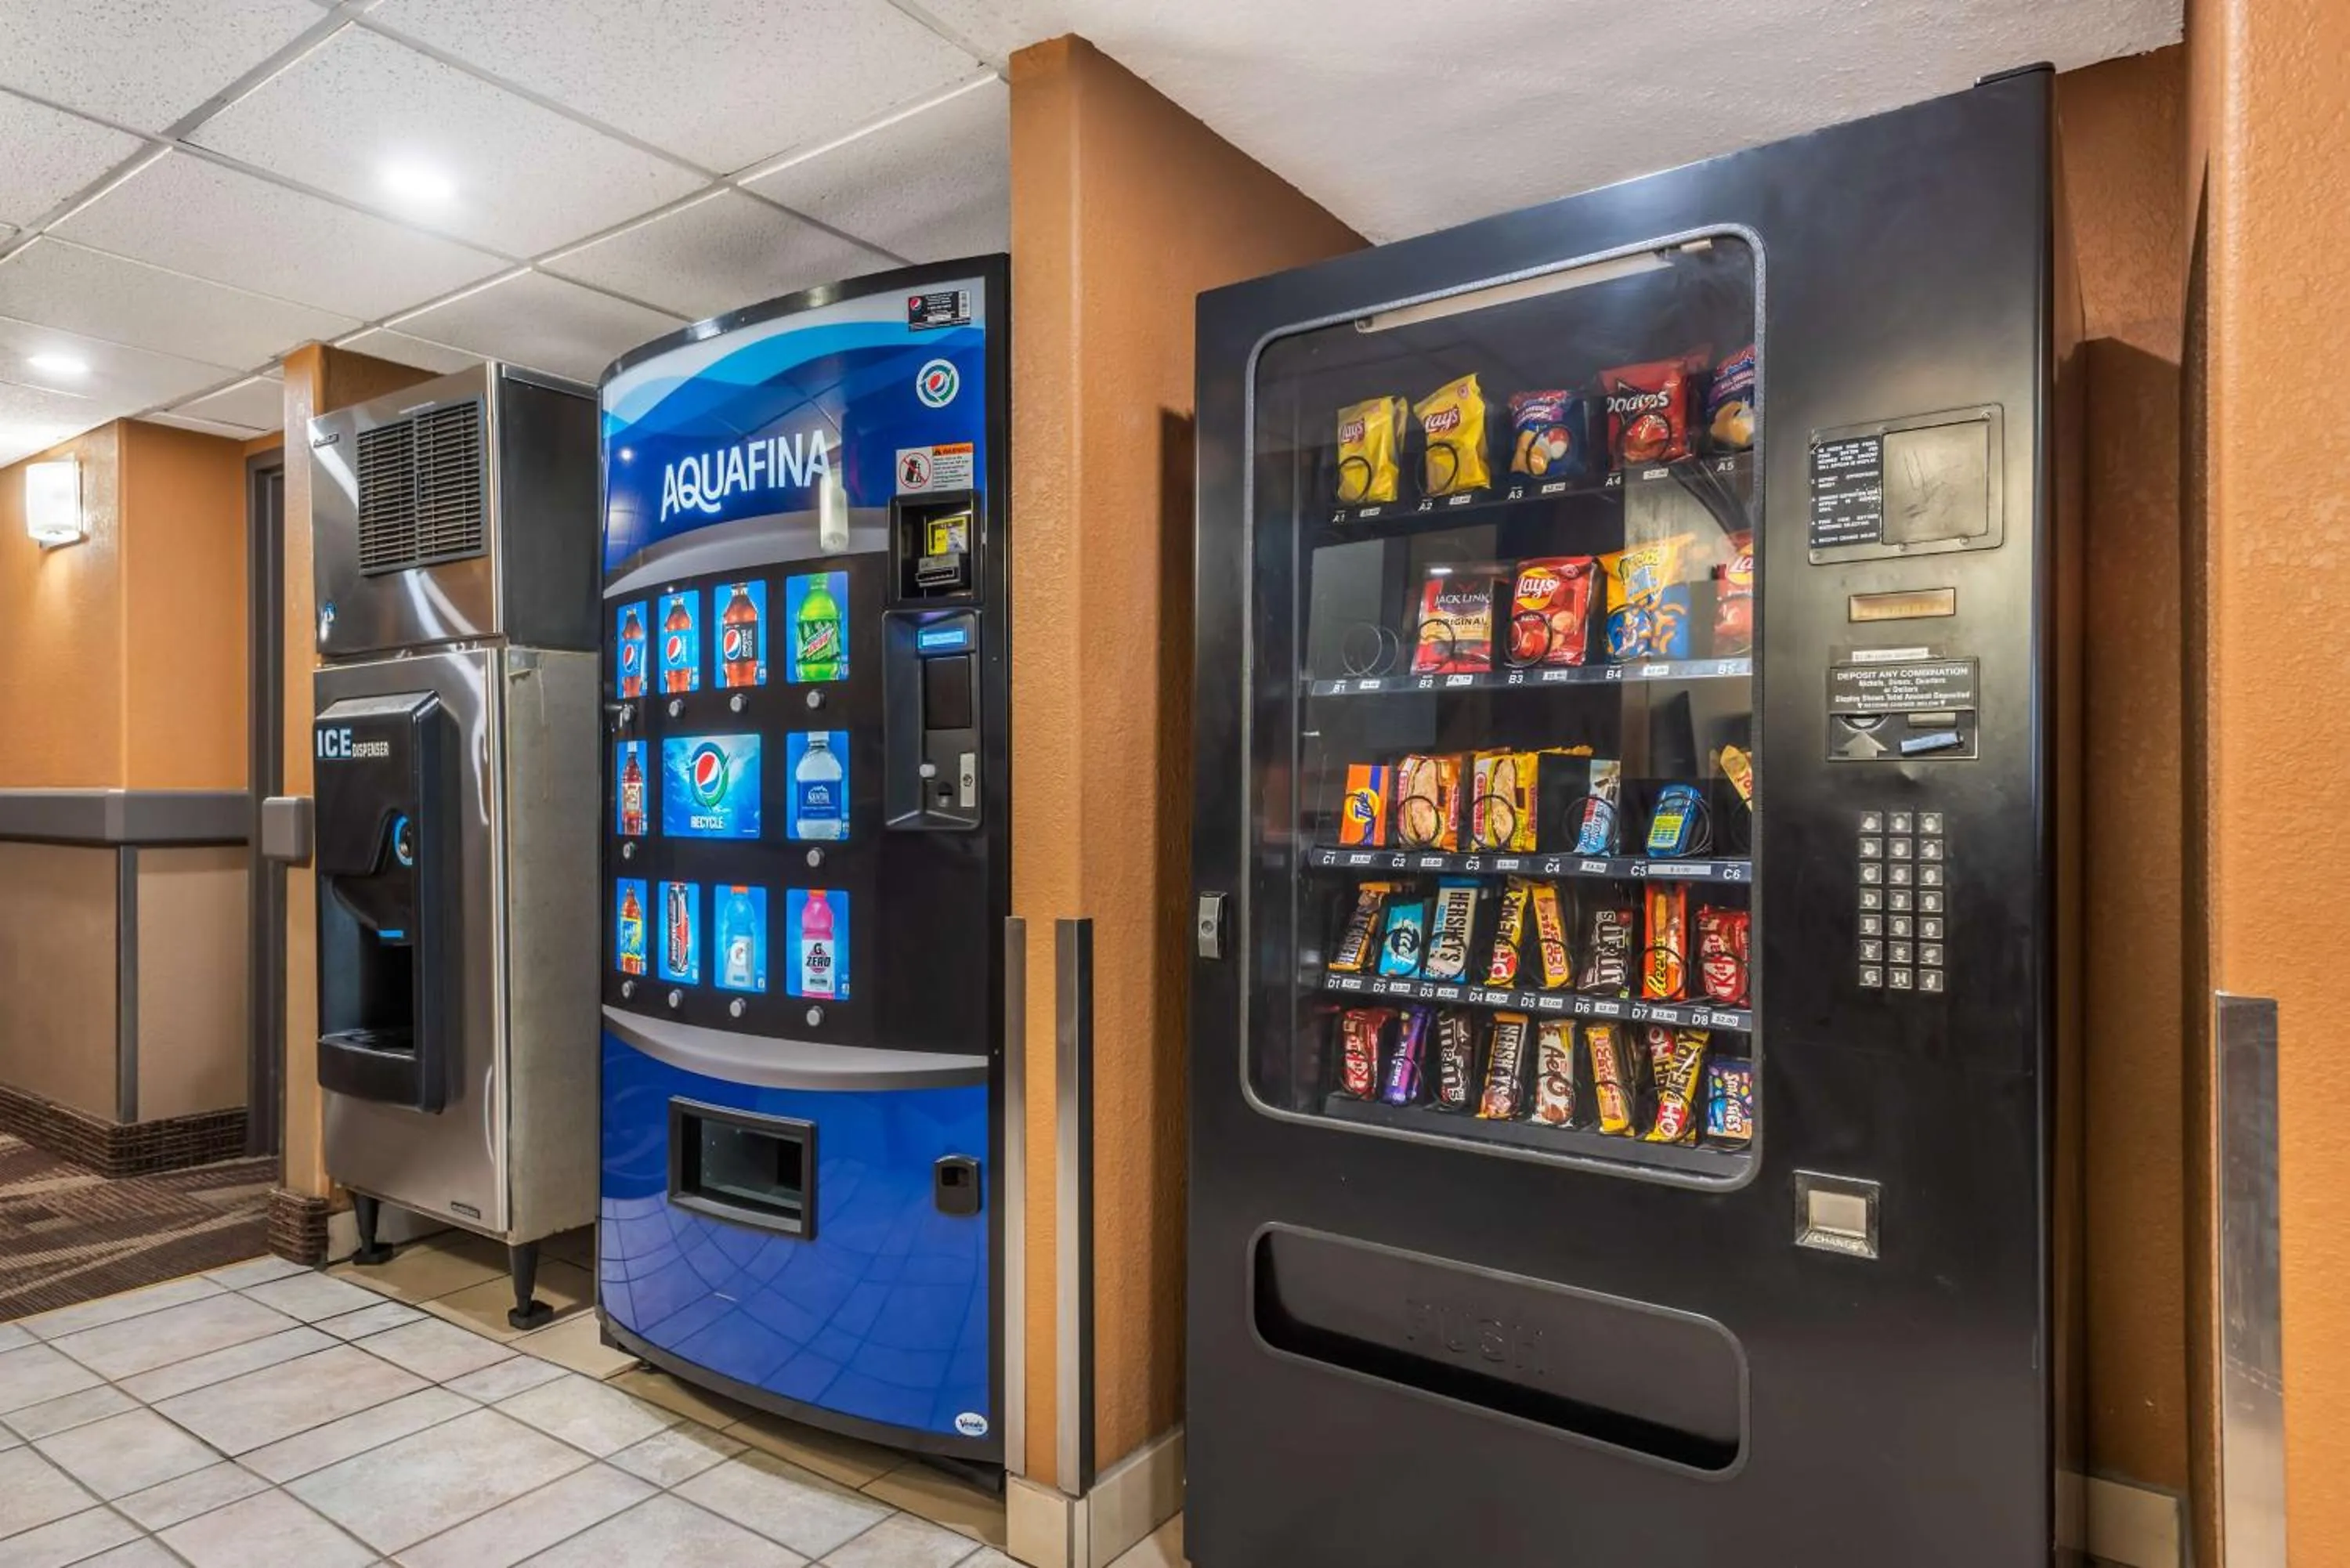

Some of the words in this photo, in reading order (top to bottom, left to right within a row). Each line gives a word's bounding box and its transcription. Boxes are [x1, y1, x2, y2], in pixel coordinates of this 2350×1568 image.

[1717, 462, 1734, 472] A5
[660, 429, 831, 523] AQUAFINA
[1606, 477, 1622, 486] A4
[1508, 490, 1524, 500] A3
[1419, 502, 1433, 511] A2
[1435, 592, 1460, 605] JACK
[1509, 674, 1524, 684] B3
[1606, 670, 1622, 679] B4
[1837, 671, 1877, 681] DEPOSIT
[1879, 670, 1898, 679] ANY
[1419, 679, 1434, 688] B2
[317, 728, 352, 758] ICE
[690, 815, 725, 829] RECYCLE
[1323, 854, 1336, 864] C1
[1392, 858, 1406, 867] C2
[1466, 861, 1480, 870] C3
[1545, 863, 1561, 873] C4
[1630, 865, 1647, 876] C5
[1723, 869, 1741, 880] C6
[1440, 892, 1470, 963] HERSHEY'S
[814, 942, 822, 953] G
[806, 956, 830, 967] ZERO
[1328, 981, 1340, 989] D1
[1372, 983, 1386, 992] D2
[1419, 988, 1433, 997] D3
[1469, 992, 1483, 1002] D4
[1520, 997, 1535, 1007] D5
[1574, 1003, 1590, 1013] D6
[1632, 1008, 1648, 1018] D7
[1692, 1014, 1708, 1025] D8
